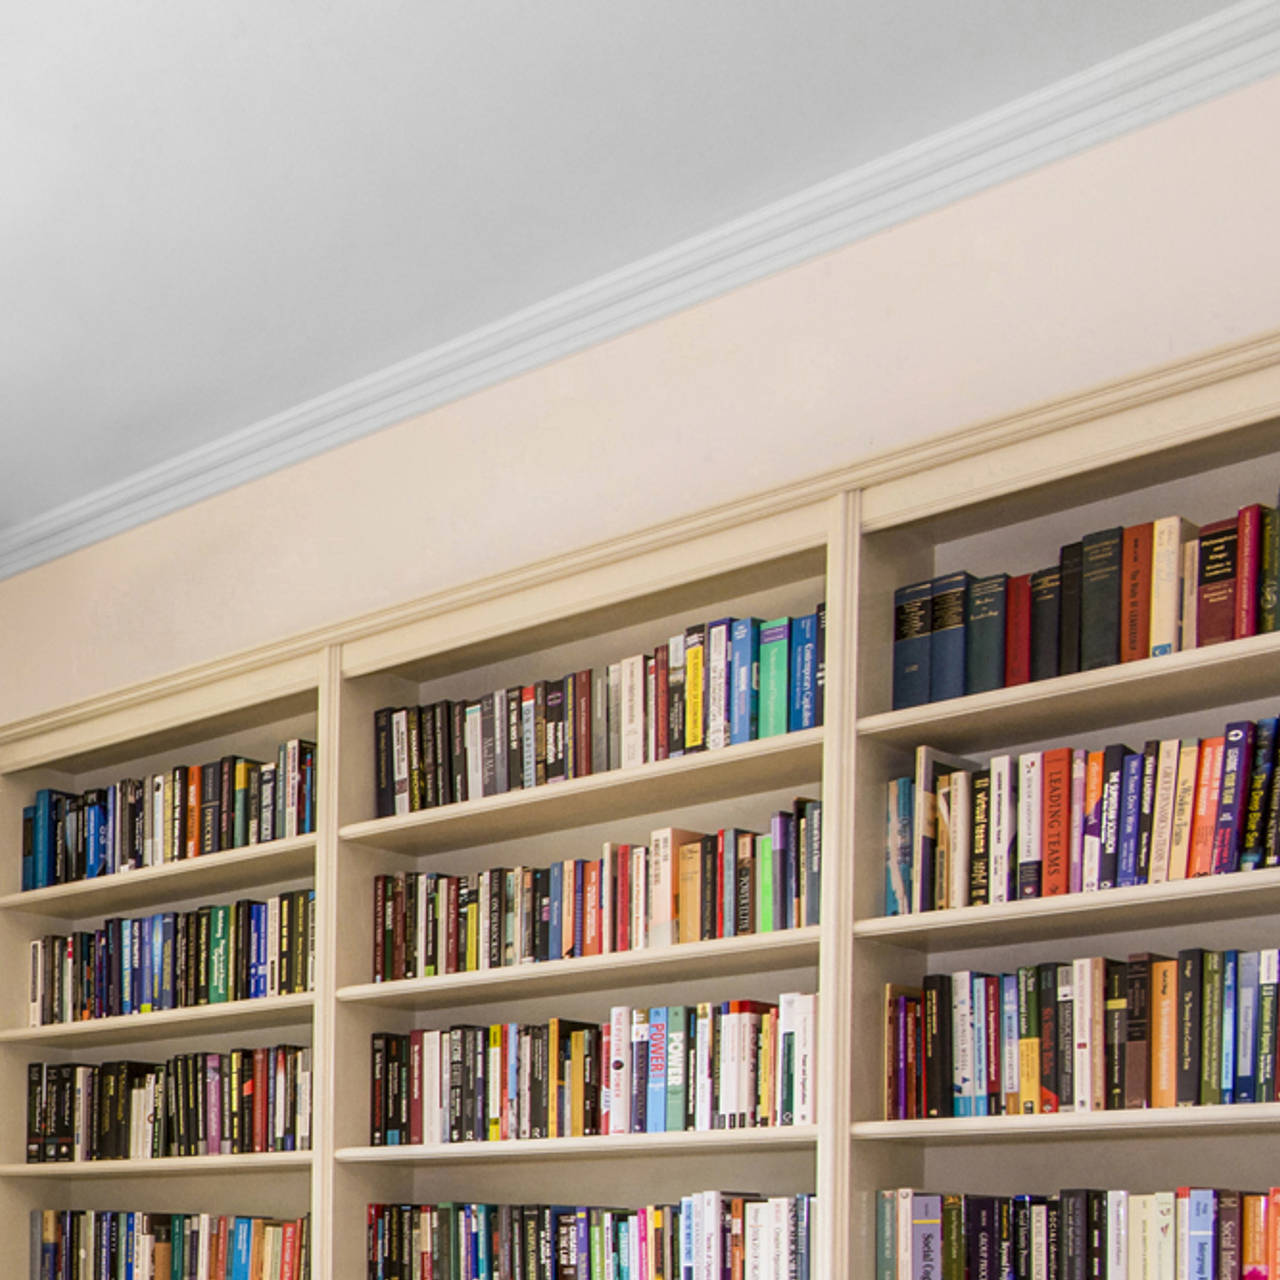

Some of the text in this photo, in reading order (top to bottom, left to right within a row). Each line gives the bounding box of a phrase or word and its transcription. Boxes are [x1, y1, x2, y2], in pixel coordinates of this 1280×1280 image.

[973, 791, 989, 854] virtual teams
[1047, 771, 1063, 877] LEADING TEAMS
[1244, 773, 1267, 849] The Deep Blue Sea
[650, 1023, 666, 1079] POWER!
[667, 1031, 684, 1087] POWER
[921, 1233, 934, 1262] Social
[978, 1232, 989, 1258] GROUP
[1049, 1211, 1057, 1241] SOCIAL
[1220, 1220, 1236, 1248] Social
[1196, 1242, 1208, 1275] Intergroup
